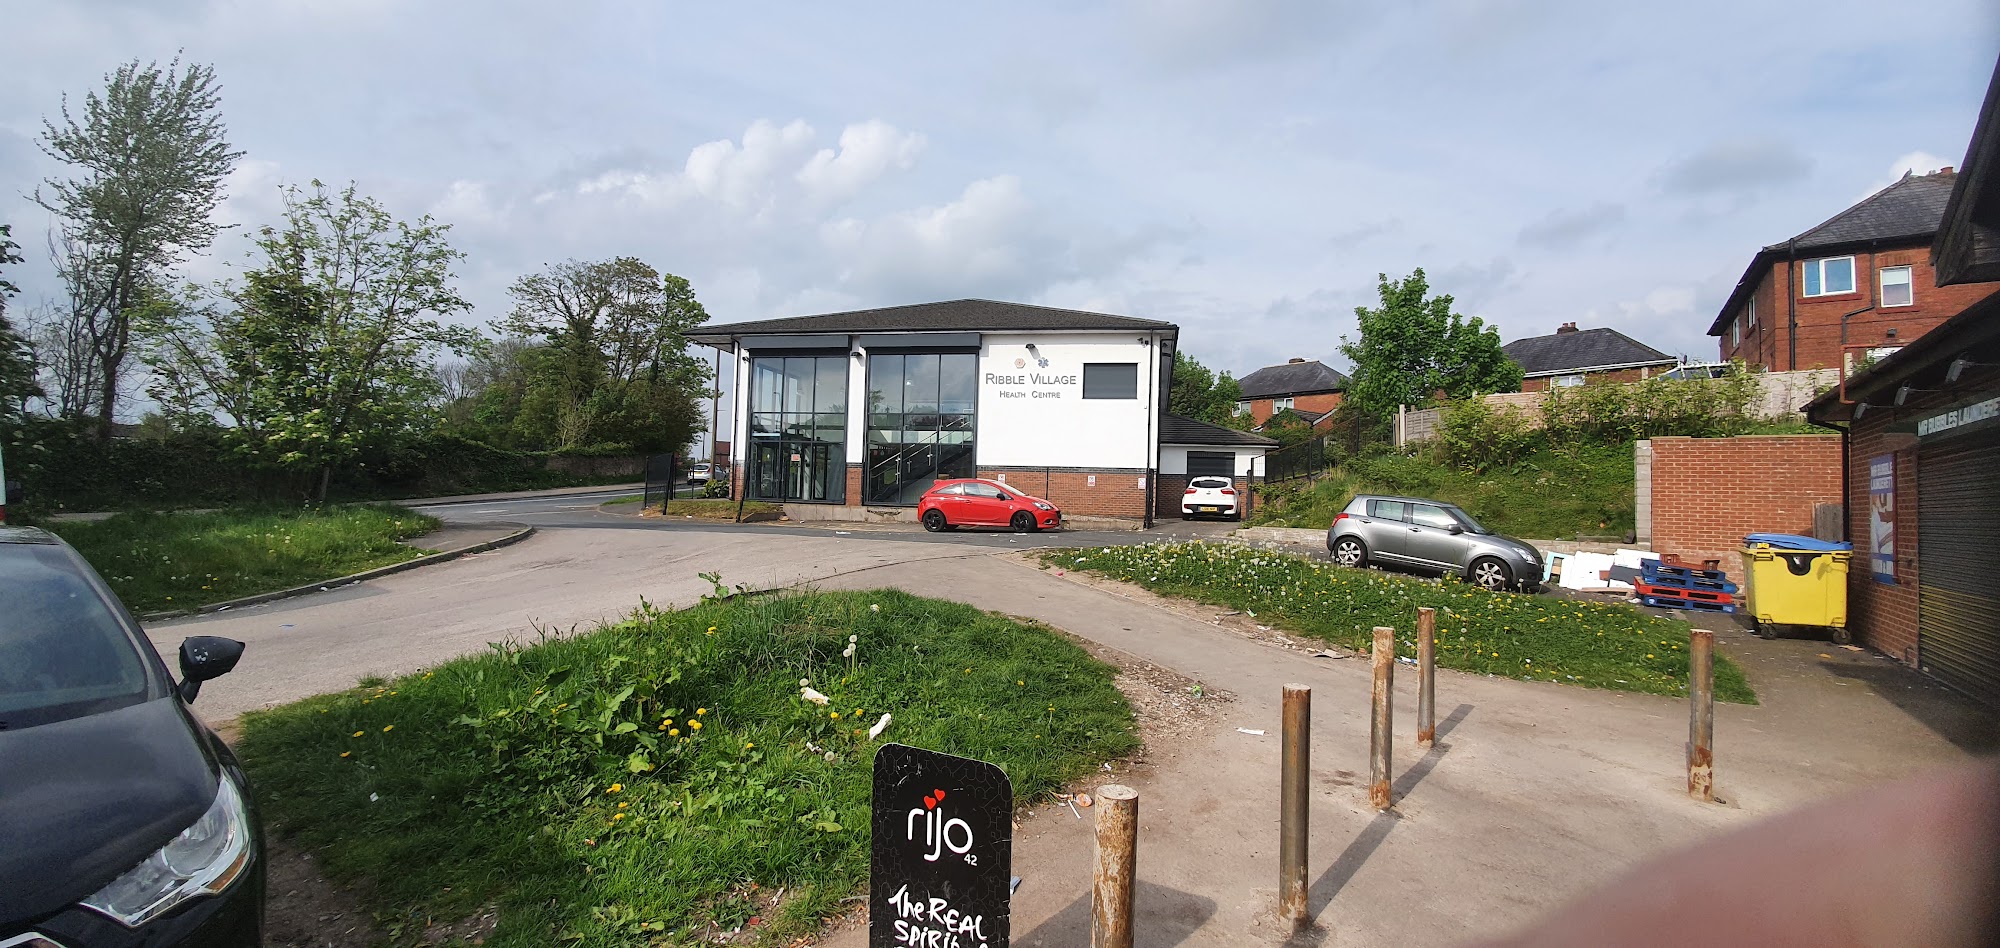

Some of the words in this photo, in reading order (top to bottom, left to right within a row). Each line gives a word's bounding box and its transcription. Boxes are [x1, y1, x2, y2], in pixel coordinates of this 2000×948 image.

[985, 373, 1025, 385] RIBBLE
[1029, 373, 1077, 385] VILLAGE
[999, 390, 1026, 399] HEALTH
[1031, 390, 1061, 399] CENTRE
[907, 806, 974, 862] rijo
[963, 853, 978, 867] 42
[888, 883, 925, 922] The
[926, 897, 988, 942] REAL
